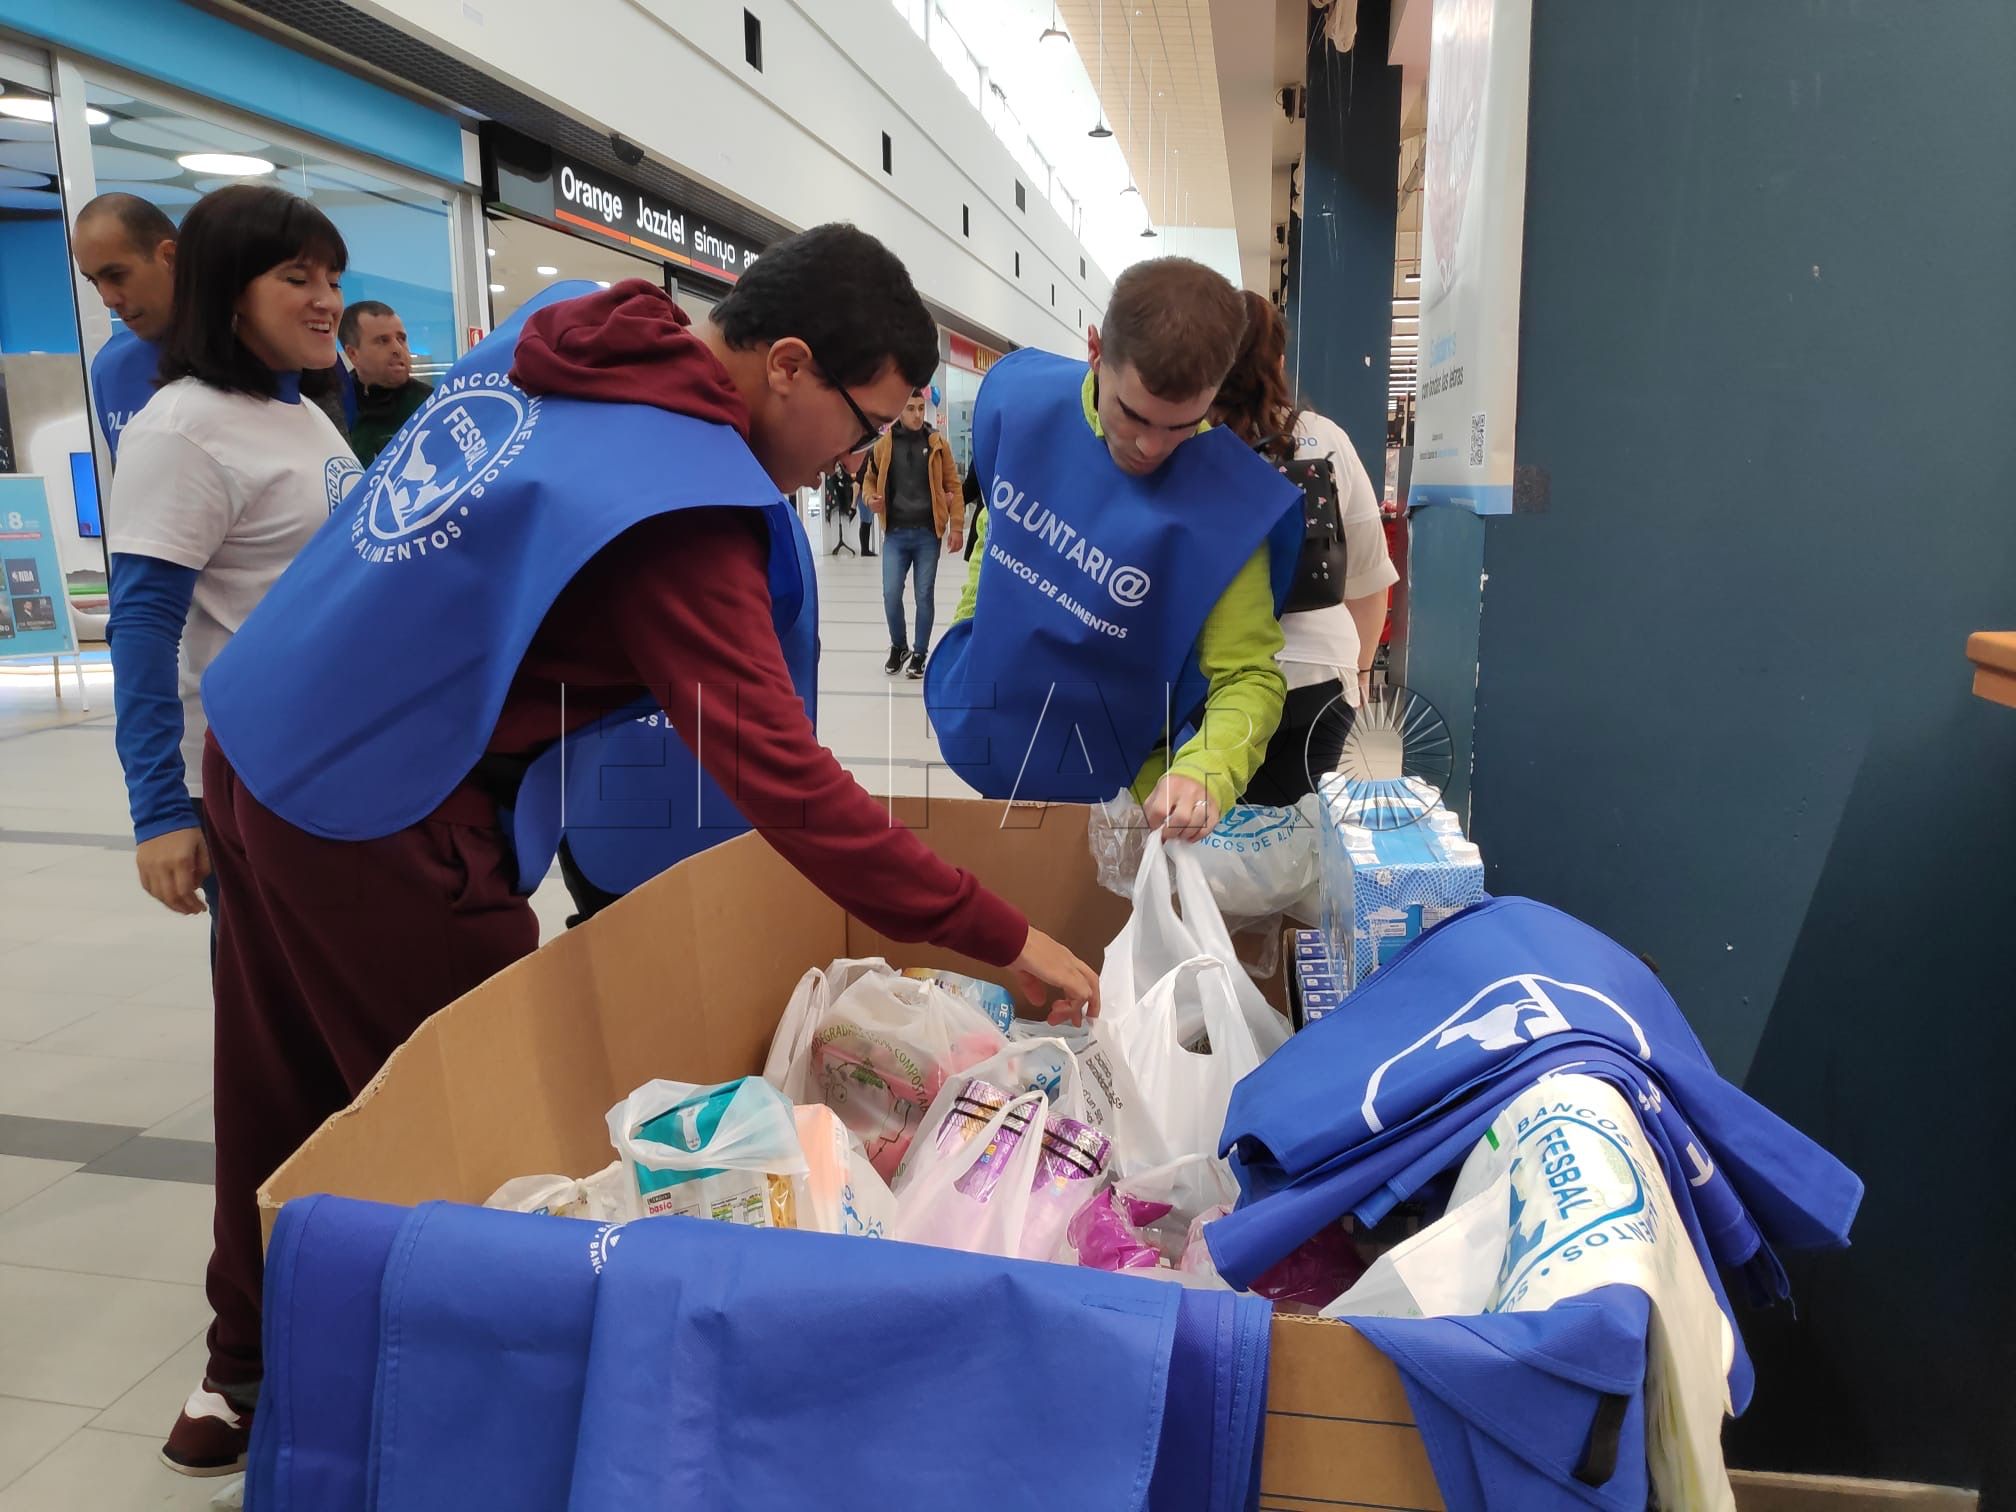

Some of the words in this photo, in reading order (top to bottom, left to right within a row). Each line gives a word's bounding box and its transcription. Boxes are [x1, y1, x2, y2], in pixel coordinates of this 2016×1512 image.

[561, 166, 623, 223] Orange
[636, 196, 685, 245] Jazztel
[694, 225, 736, 269] simyo
[989, 543, 1040, 585] BANCOS
[1038, 578, 1058, 598] DE
[1056, 592, 1128, 639] ALIMENTOS
[1518, 1102, 1634, 1149] BANCOS
[1535, 1126, 1593, 1220] FESBAL
[589, 1241, 603, 1275] BANC
